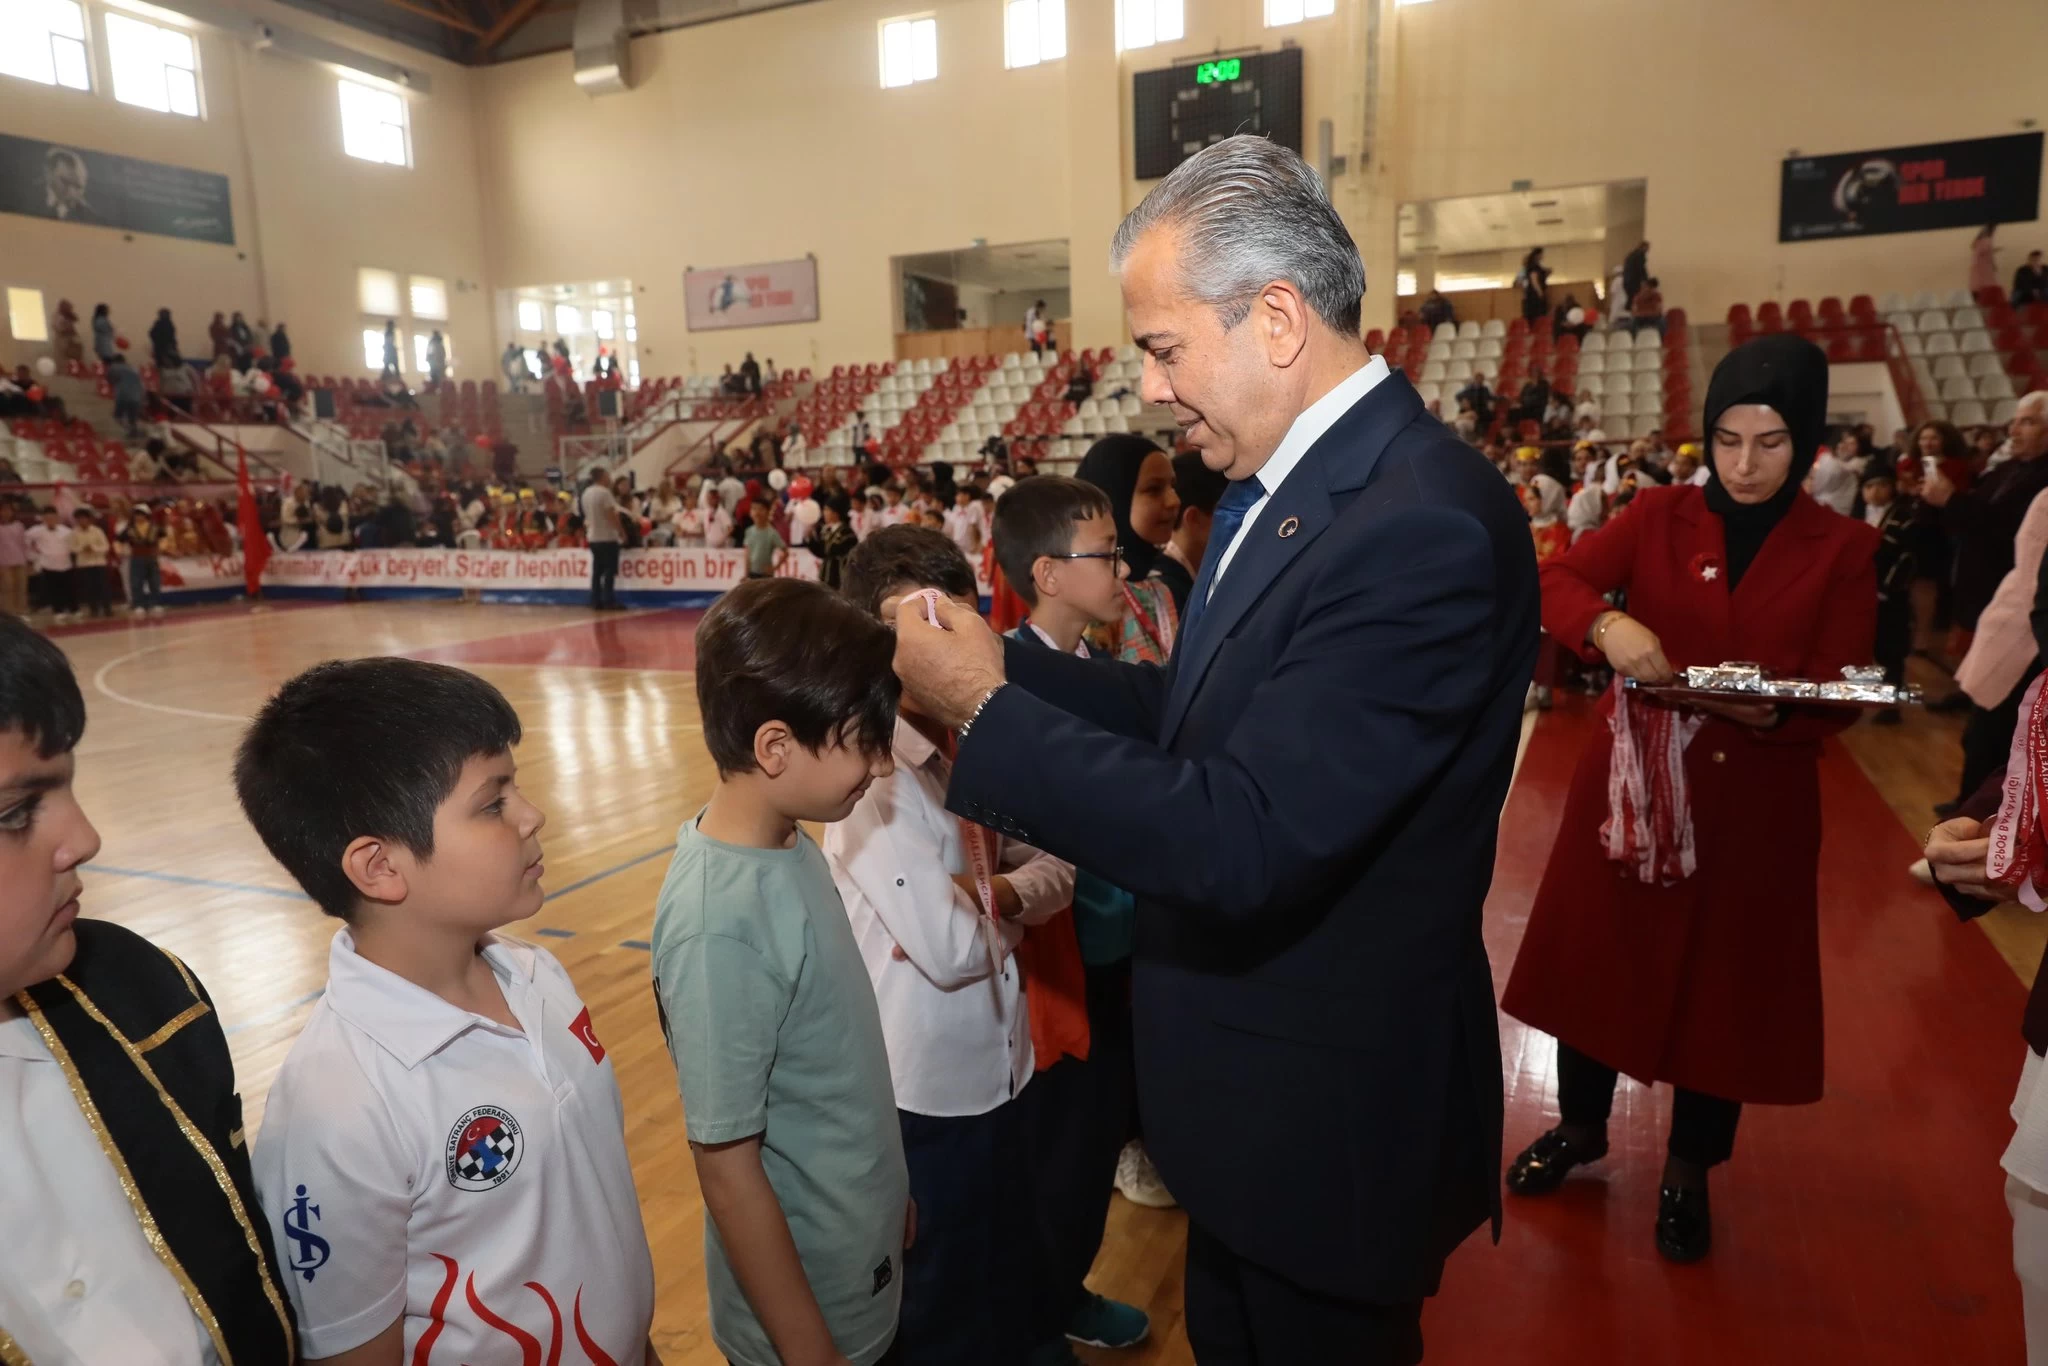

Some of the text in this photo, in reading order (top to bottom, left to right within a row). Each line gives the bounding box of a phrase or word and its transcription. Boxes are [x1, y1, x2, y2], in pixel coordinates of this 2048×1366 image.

[1197, 59, 1240, 83] 12:00
[455, 553, 510, 578] Sizler
[516, 553, 588, 582] hepiniz
[703, 553, 737, 579] bir
[449, 1115, 472, 1152] SATRANÇ
[472, 1108, 520, 1136] FEDERASYONU
[492, 1169, 511, 1185] 1991
